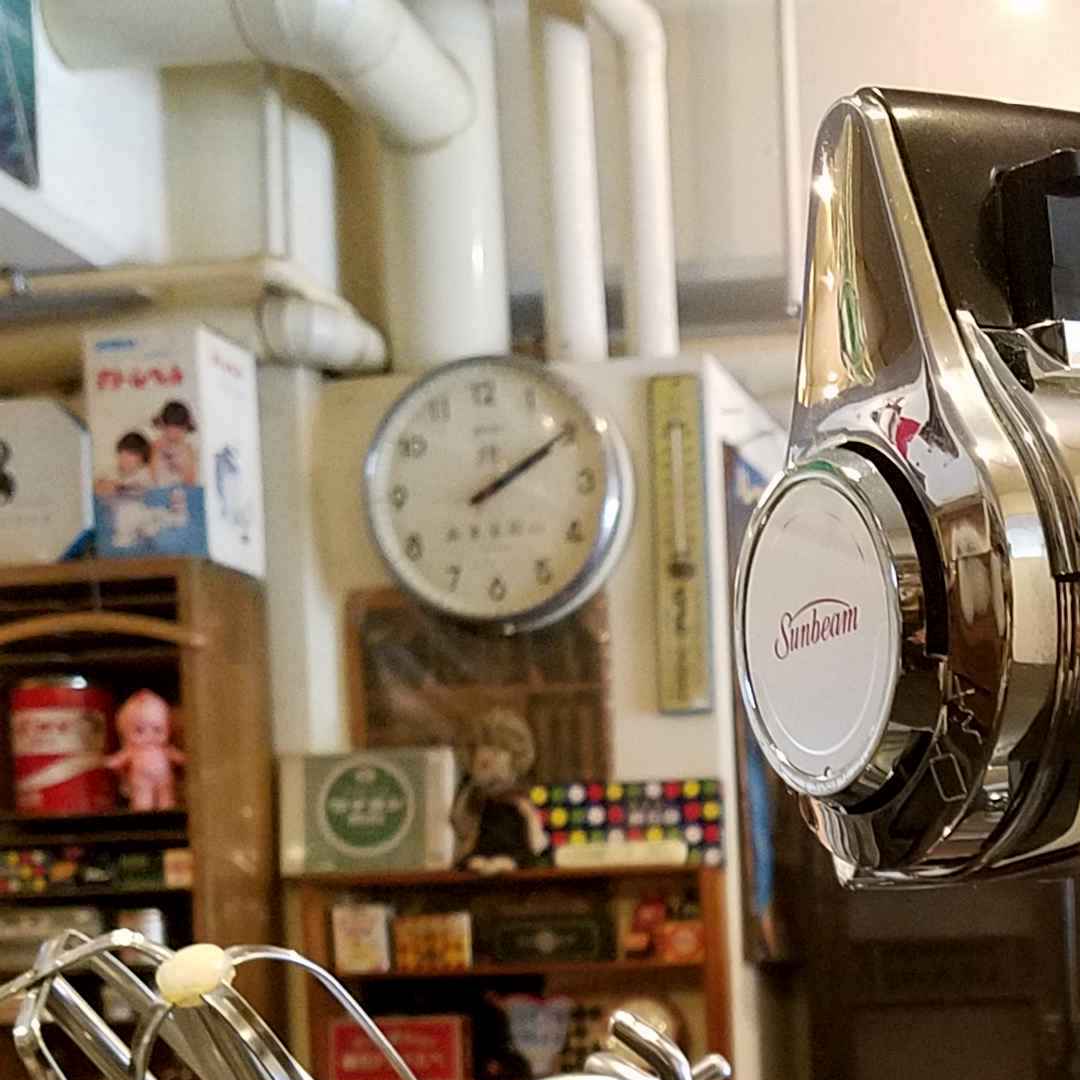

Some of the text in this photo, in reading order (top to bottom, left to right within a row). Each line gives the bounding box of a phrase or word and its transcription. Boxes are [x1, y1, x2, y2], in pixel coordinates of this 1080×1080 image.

[470, 380, 497, 407] 12
[577, 467, 596, 495] 3
[389, 484, 408, 511] 9
[565, 519, 583, 544] 4
[405, 532, 423, 562] 8
[447, 564, 462, 592] 7
[534, 558, 553, 586] 5
[488, 577, 507, 601] 6
[774, 598, 858, 660] Sunbeam
